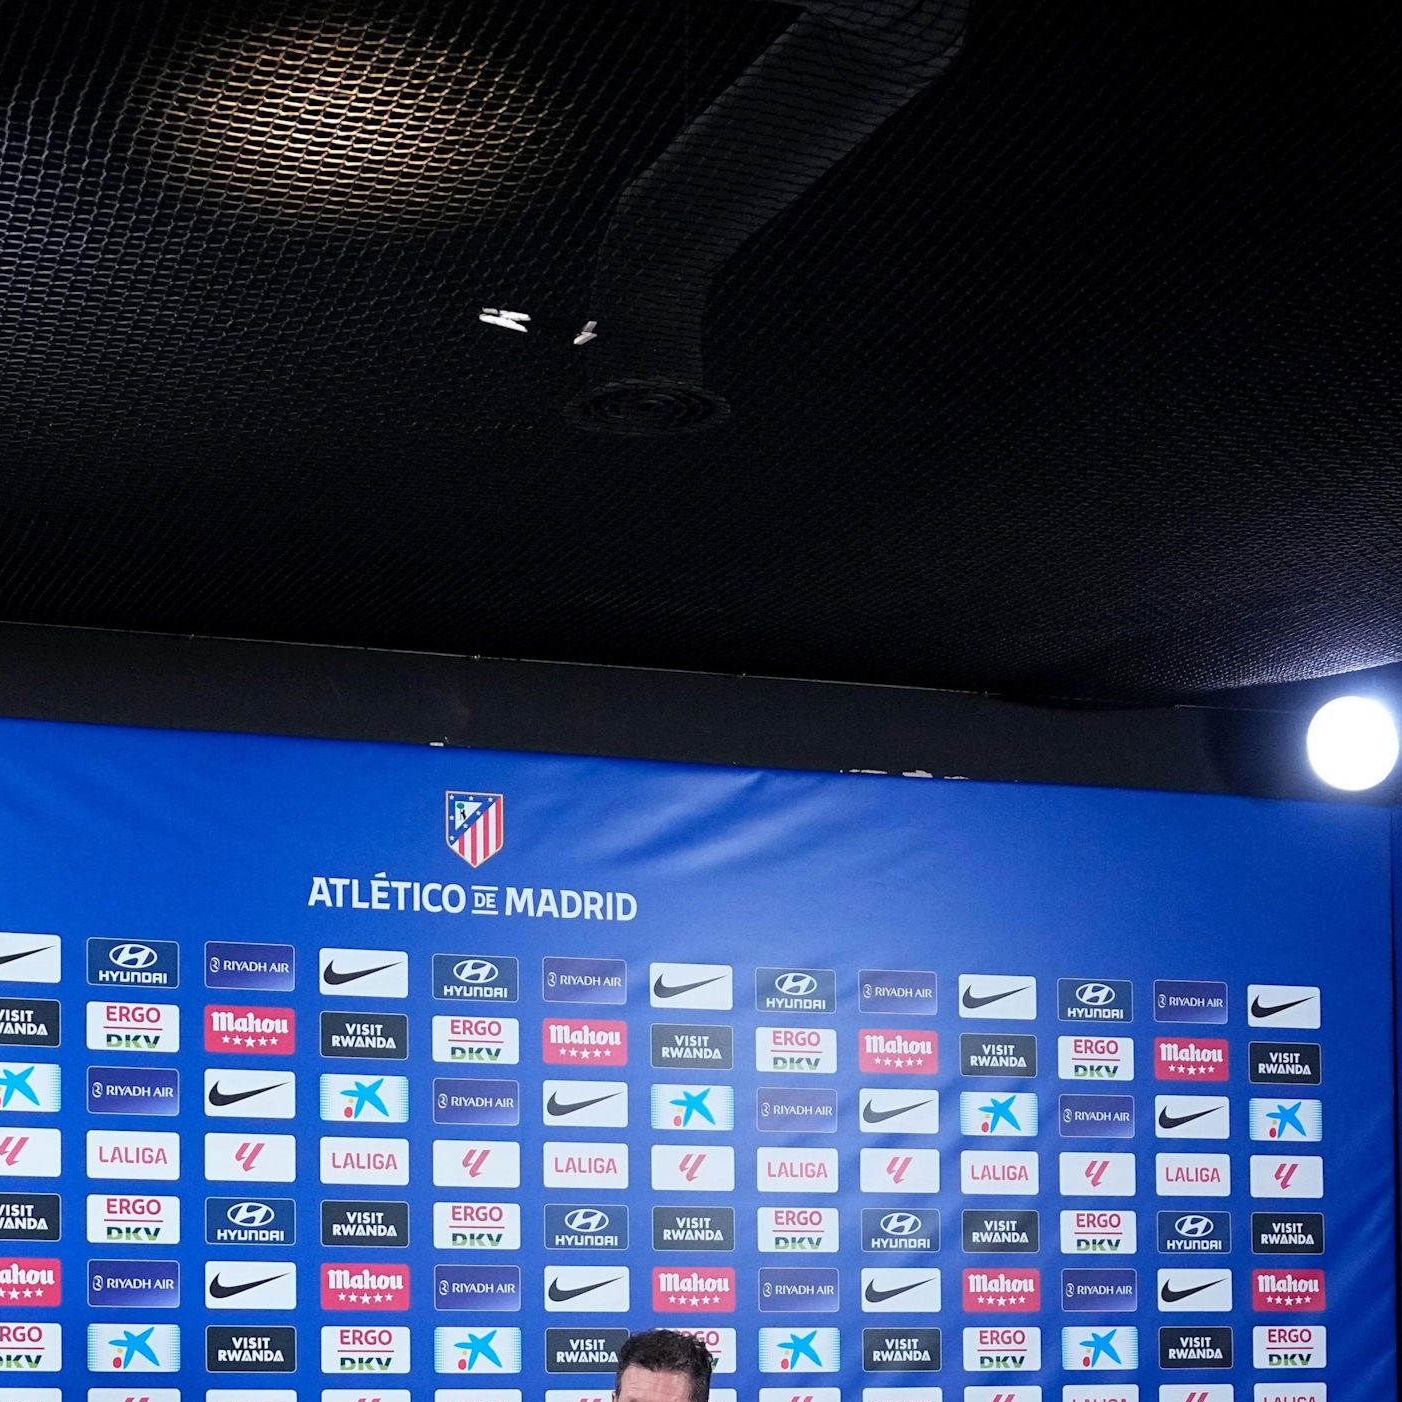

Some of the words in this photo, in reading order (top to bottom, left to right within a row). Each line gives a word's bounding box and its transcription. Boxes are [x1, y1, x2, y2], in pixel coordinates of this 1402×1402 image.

[308, 871, 466, 914] ATLÉTICO
[473, 891, 497, 909] DE
[505, 886, 638, 921] MADRID
[98, 970, 167, 984] HYUNDAI
[560, 974, 601, 986] RIYADH
[602, 976, 622, 987] AIR
[766, 997, 826, 1010] HYUNDAI
[1169, 996, 1205, 1007] RIYADH
[1206, 998, 1223, 1008] AIR
[1067, 1007, 1124, 1019] HYUNDAI
[211, 1011, 289, 1034] Mahou
[450, 1019, 502, 1037] ERGO
[548, 1024, 622, 1046] Mahou
[674, 1035, 709, 1047] VISIT
[450, 1046, 502, 1061] DKV
[661, 1046, 722, 1060] RWANDA
[981, 1044, 1015, 1056] VISIT
[1073, 1039, 1119, 1055] ERGO
[1159, 1043, 1224, 1063] Mahou
[970, 1055, 1027, 1068] RWANDA
[1074, 1064, 1119, 1078] DKV
[106, 1085, 151, 1097] RIYADH
[152, 1087, 174, 1098] AIR
[773, 1105, 813, 1115] RIYADH
[814, 1106, 833, 1116] AIR
[99, 1146, 168, 1165] LALIGA
[332, 1152, 398, 1170] LALIGA
[767, 1161, 828, 1178] LALIGA
[971, 1164, 1029, 1181] LALIGA
[106, 1198, 161, 1216] ERGO
[346, 1211, 384, 1224] VISIT
[774, 1210, 823, 1226] ERGO
[332, 1224, 398, 1237] RWANDA
[983, 1220, 1017, 1232] VISIT
[106, 1226, 161, 1241] DKV
[217, 1229, 284, 1241] HYUNDAI
[972, 1231, 1029, 1243] RWANDA
[774, 1236, 823, 1250] DKV
[871, 1238, 930, 1249] HYUNDAI
[1167, 1239, 1222, 1250] HYUNDAI
[106, 1278, 152, 1289] RIYADH
[153, 1279, 175, 1290] AIR
[327, 1269, 404, 1290] Mahou
[658, 1272, 730, 1293] Mahou
[1257, 1274, 1320, 1293] Mahou
[775, 1285, 815, 1295] RIYADH
[816, 1285, 835, 1295] AIR
[979, 1329, 1026, 1345] ERGO
[1179, 1336, 1212, 1348] VISIT
[1268, 1328, 1312, 1343] ERGO
[231, 1337, 271, 1350] VISIT
[569, 1338, 606, 1351] VISIT
[218, 1349, 285, 1362] RWANDA
[556, 1351, 619, 1363] RWANDA
[1168, 1348, 1223, 1360] RWANDA
[1268, 1353, 1312, 1366] DKV
[979, 1355, 1026, 1369] DKV
